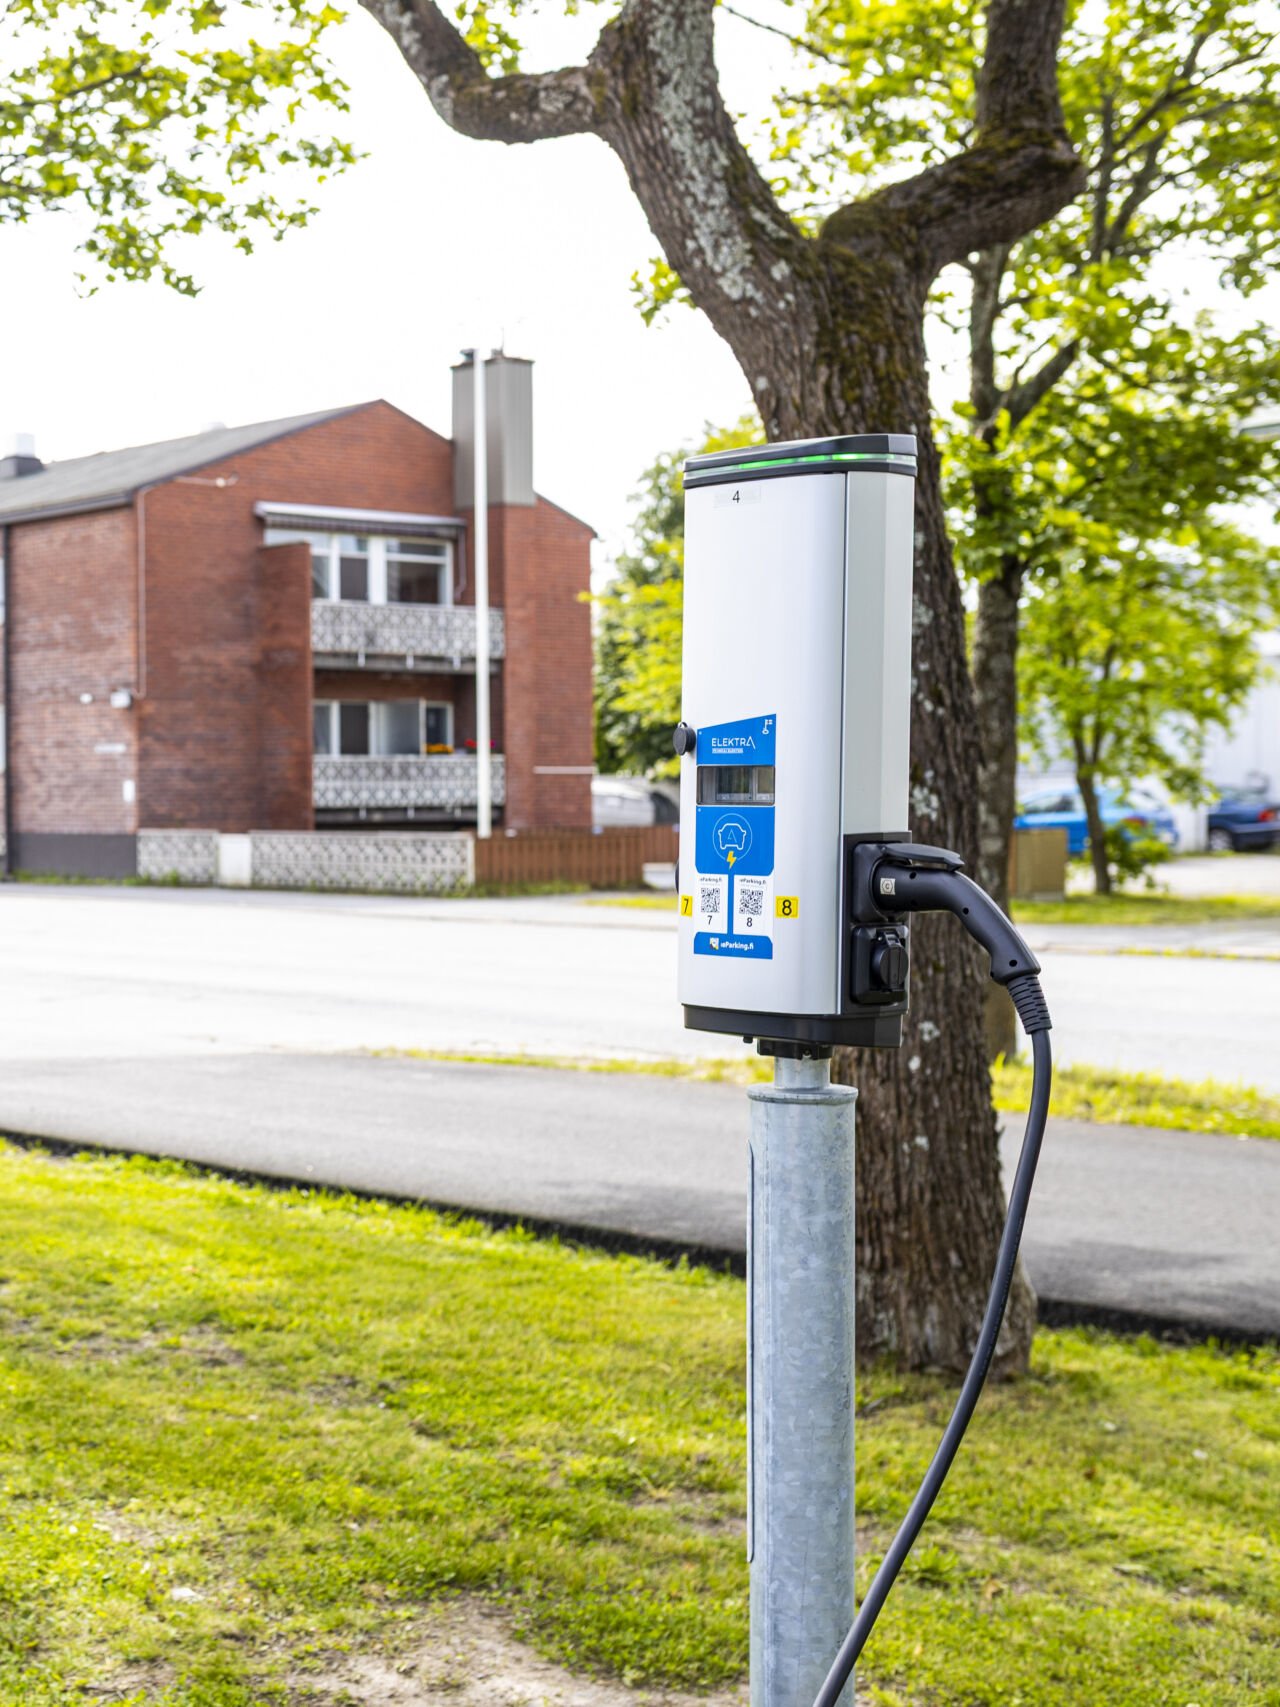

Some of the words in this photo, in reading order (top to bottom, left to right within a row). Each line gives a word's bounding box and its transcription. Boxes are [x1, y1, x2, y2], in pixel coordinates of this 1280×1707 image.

[732, 490, 740, 503] 4
[711, 735, 756, 750] ELEKTRA
[683, 898, 689, 914] 7
[782, 899, 792, 916] 8
[707, 915, 713, 926] 7
[746, 917, 753, 928] 8
